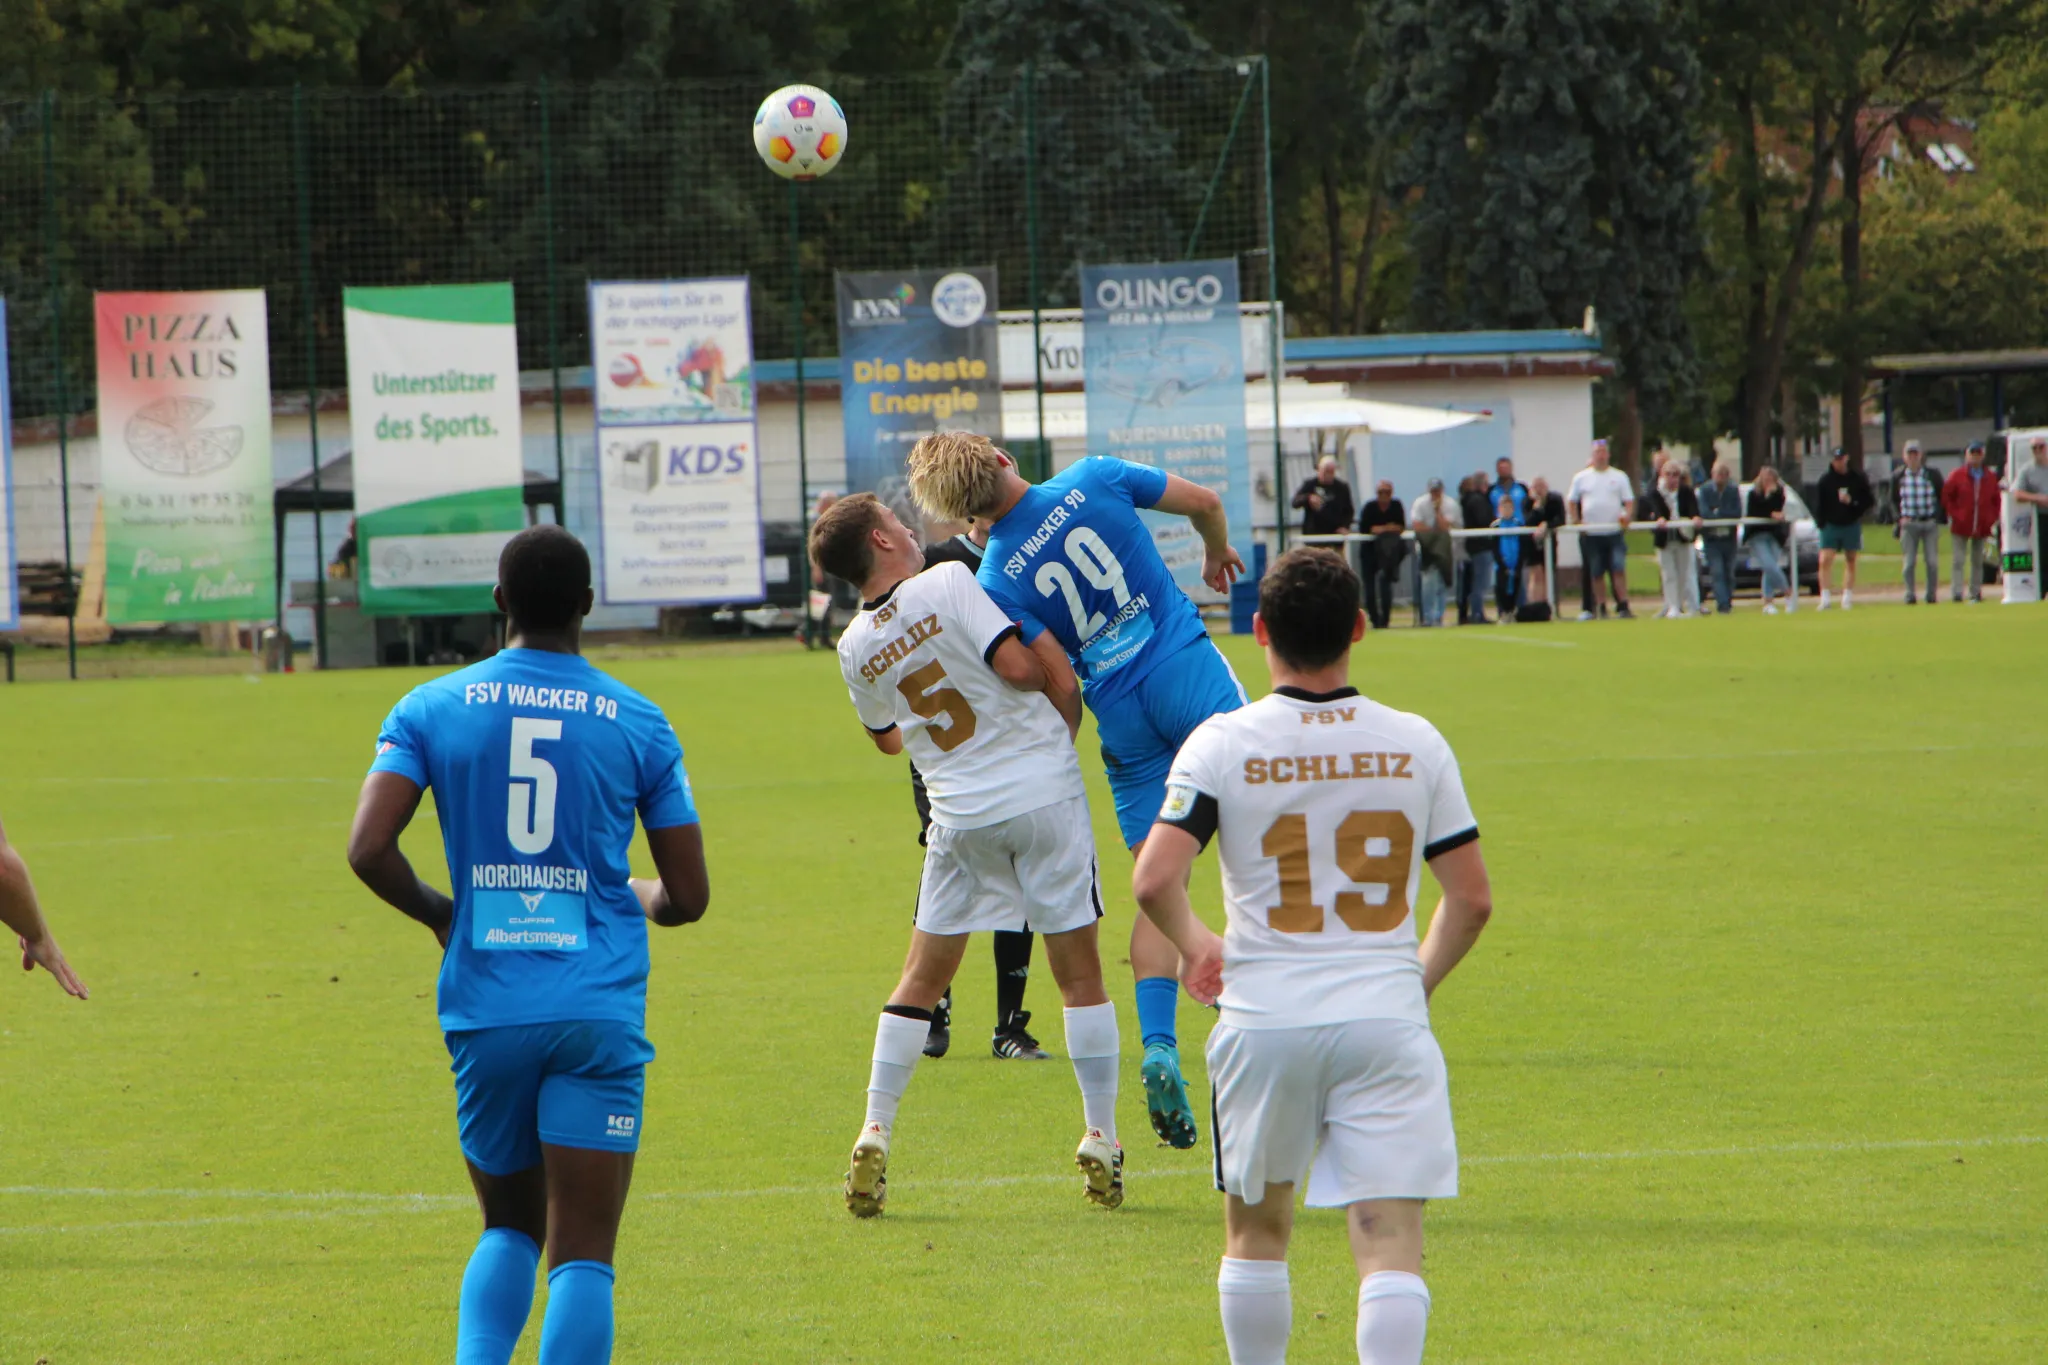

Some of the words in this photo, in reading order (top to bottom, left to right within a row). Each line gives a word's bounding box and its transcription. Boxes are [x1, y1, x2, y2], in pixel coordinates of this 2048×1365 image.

[1096, 274, 1223, 310] OLINGO
[123, 312, 242, 343] PIZZA
[130, 349, 238, 380] HAUS
[853, 358, 901, 383] Die
[905, 357, 987, 382] beste
[373, 369, 496, 396] Unterstützer
[869, 387, 979, 419] Energie
[375, 415, 413, 440] des
[420, 414, 498, 444] Sports.
[668, 443, 746, 476] KDS
[1003, 552, 1027, 580] FSV
[1020, 505, 1071, 558] WACKER
[1064, 488, 1086, 510] 90
[1034, 526, 1132, 643] 29
[465, 682, 502, 704] FSV
[508, 684, 588, 713] WACKER
[595, 695, 617, 720] 90
[896, 657, 976, 752] 5
[1300, 707, 1357, 725] FSV
[1243, 752, 1413, 784] SCHLEIZ
[507, 717, 562, 854] 5
[472, 864, 587, 893] NORDHAUSEN
[1261, 810, 1415, 933] 19
[484, 928, 577, 948] Albertsmeyer
